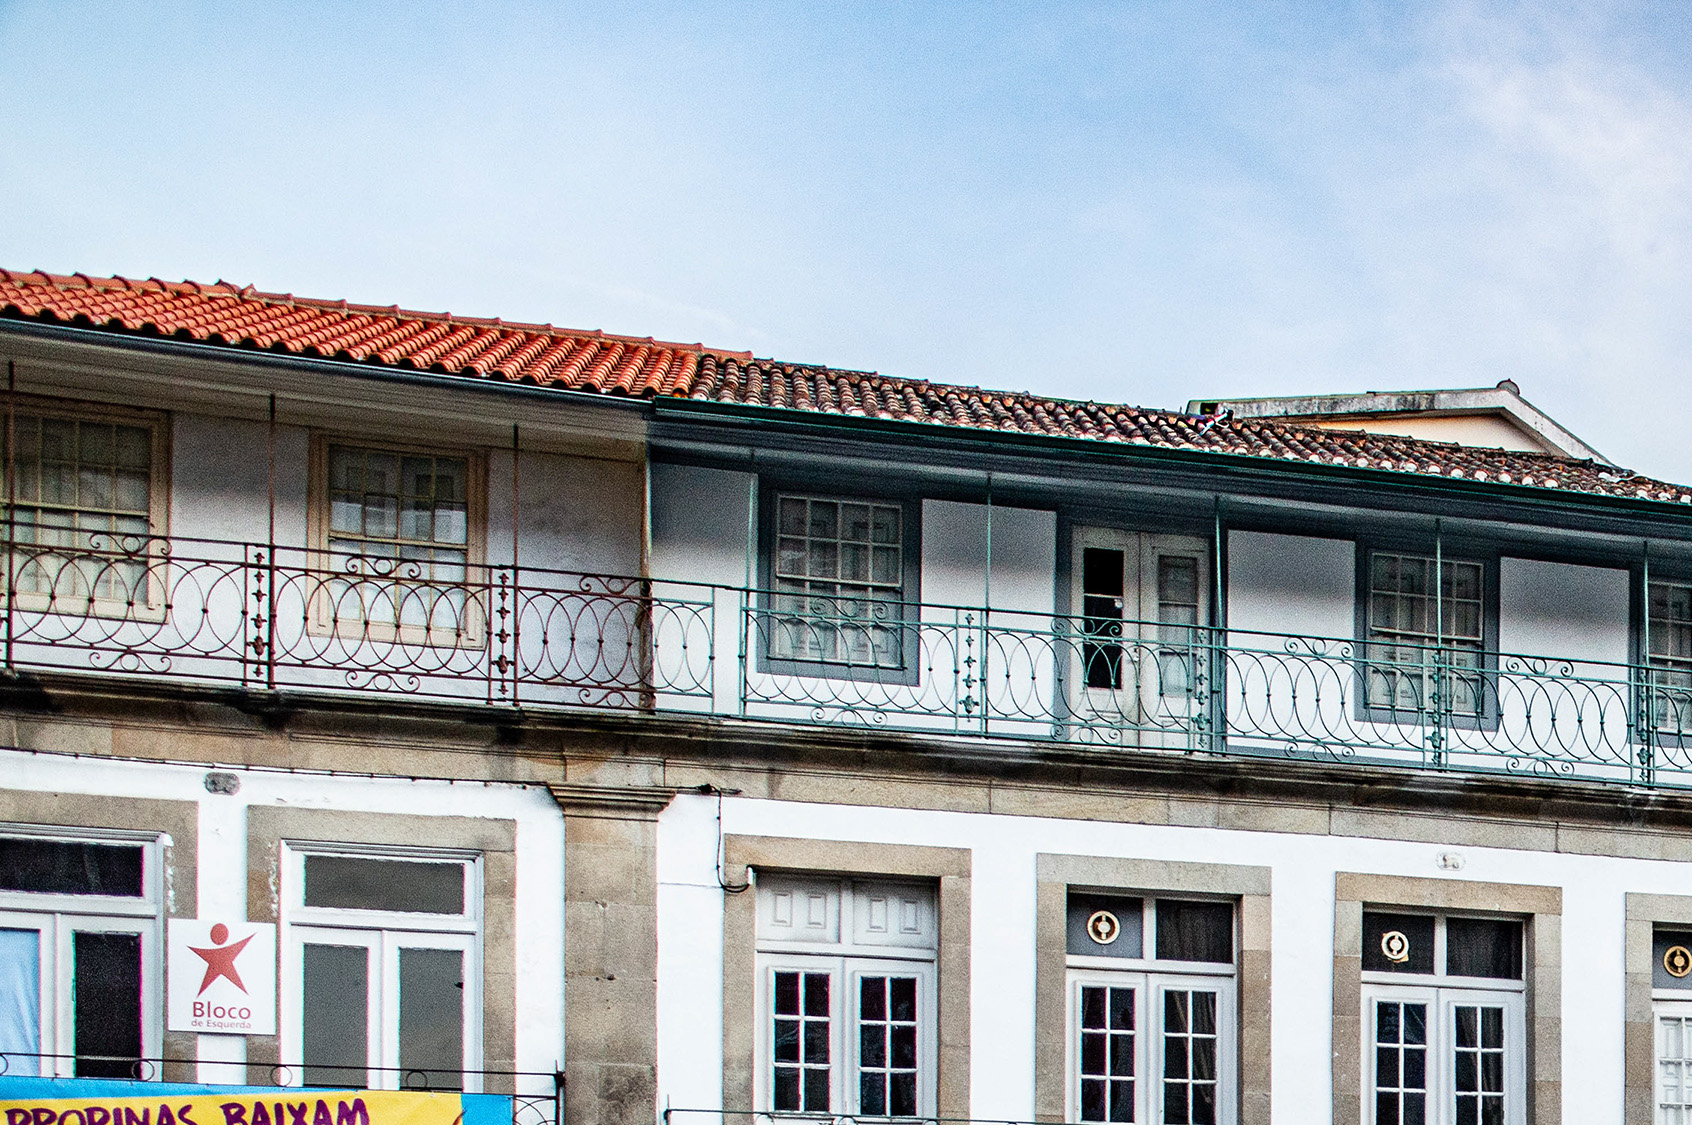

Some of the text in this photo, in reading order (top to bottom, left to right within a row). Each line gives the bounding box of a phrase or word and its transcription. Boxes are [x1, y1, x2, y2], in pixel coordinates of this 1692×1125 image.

[192, 1001, 252, 1020] Bloco
[191, 1019, 252, 1030] de Esquerda
